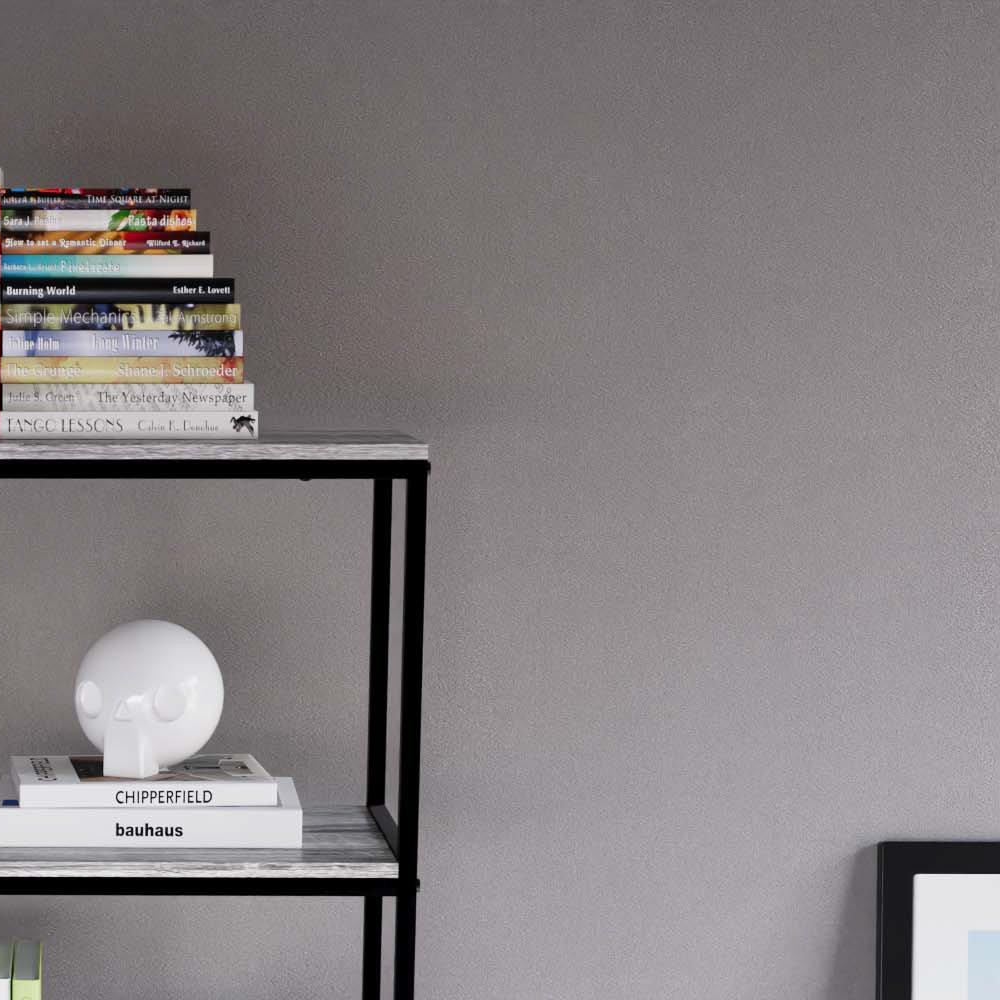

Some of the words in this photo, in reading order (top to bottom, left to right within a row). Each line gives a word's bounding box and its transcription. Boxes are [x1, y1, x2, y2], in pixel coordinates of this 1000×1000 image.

[110, 194, 143, 205] SQUARE
[159, 194, 189, 204] NIGHT
[3, 215, 23, 226] Sara
[128, 214, 158, 226] Pasta
[159, 214, 194, 226] dishes
[4, 238, 24, 248] How
[26, 239, 35, 247] to
[60, 238, 97, 248] Romantic
[6, 286, 44, 298] Burning
[46, 285, 76, 296] World
[173, 286, 196, 294] Esther
[198, 286, 205, 294] E.
[207, 286, 231, 294] Lovett
[6, 307, 58, 327] Simple
[60, 306, 136, 325] Mechanics
[178, 311, 237, 326] Armstrong
[37, 335, 60, 351] Holm
[122, 334, 160, 351] Winter
[7, 363, 29, 377] The
[172, 363, 238, 377] Schroeder
[7, 391, 31, 403] Julie
[97, 391, 119, 403] The
[121, 391, 178, 407] Yesterday
[182, 391, 248, 407] Newspaper
[7, 418, 56, 433] TANGO
[61, 418, 124, 433] LESSONS
[115, 789, 213, 805] CHIPPERFIELD
[115, 822, 184, 838] bauhaus
